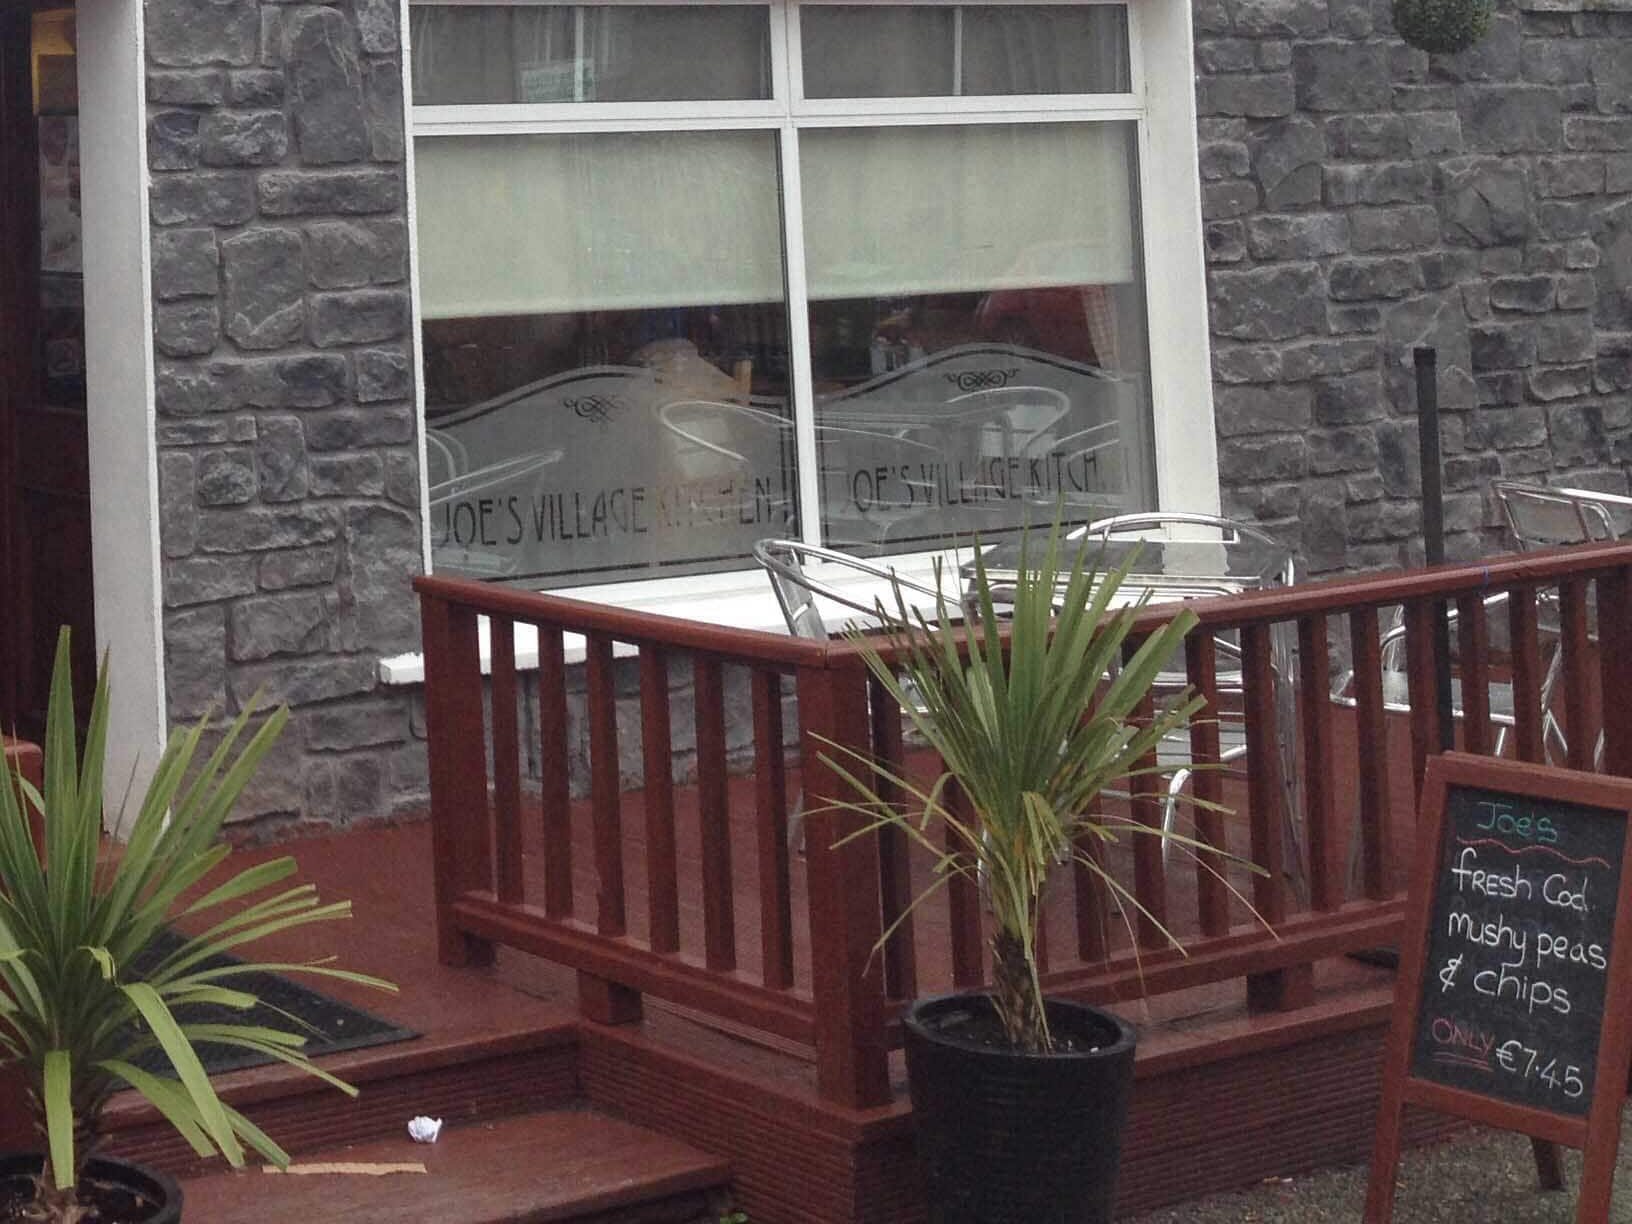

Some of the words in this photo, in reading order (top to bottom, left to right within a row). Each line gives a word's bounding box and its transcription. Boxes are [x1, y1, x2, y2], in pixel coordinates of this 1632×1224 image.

[843, 464, 915, 514] OE'S
[439, 495, 523, 548] JOE'S
[529, 487, 649, 543] VILLAGE
[1476, 801, 1559, 844] Joe's
[1536, 931, 1608, 970] peas
[1439, 953, 1464, 993] &
